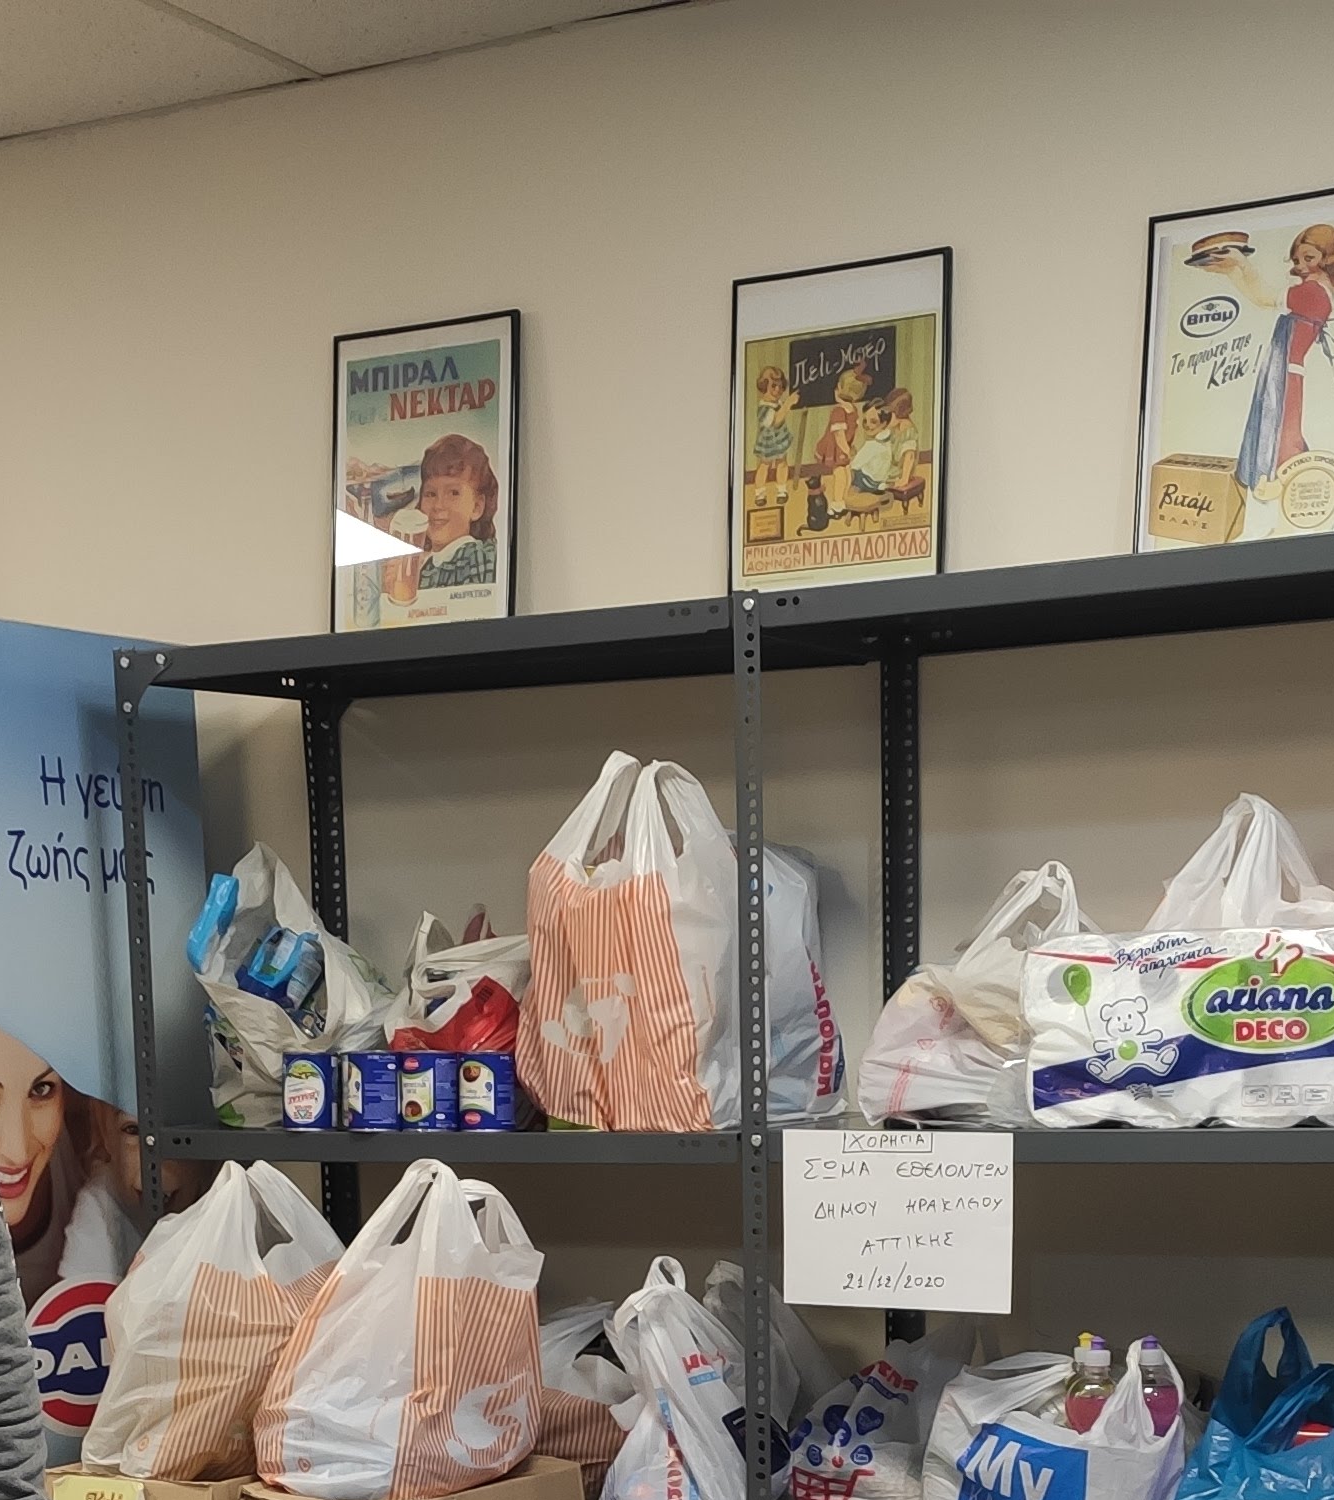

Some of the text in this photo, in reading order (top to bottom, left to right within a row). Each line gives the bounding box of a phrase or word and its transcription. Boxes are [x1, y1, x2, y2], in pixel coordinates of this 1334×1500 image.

[349, 355, 460, 396] ΜΠΙΡΑΛ
[389, 378, 496, 422] ΝΕΚΤΑΡ
[40, 755, 165, 819] Η γεύη
[7, 830, 91, 893] ζωής
[1235, 1019, 1308, 1042] DECO
[849, 1133, 925, 1150] ΧΟΡΗΓΙΑ
[803, 1158, 1009, 1180] ΣΩΜΑ ΕΘΕΛΟΝΤΩΝ
[814, 1200, 878, 1220] ΔΗΜΟΥ
[861, 1231, 955, 1256] ΑΤΤΙΚΗΣ
[842, 1261, 946, 1293] 21/12/2020
